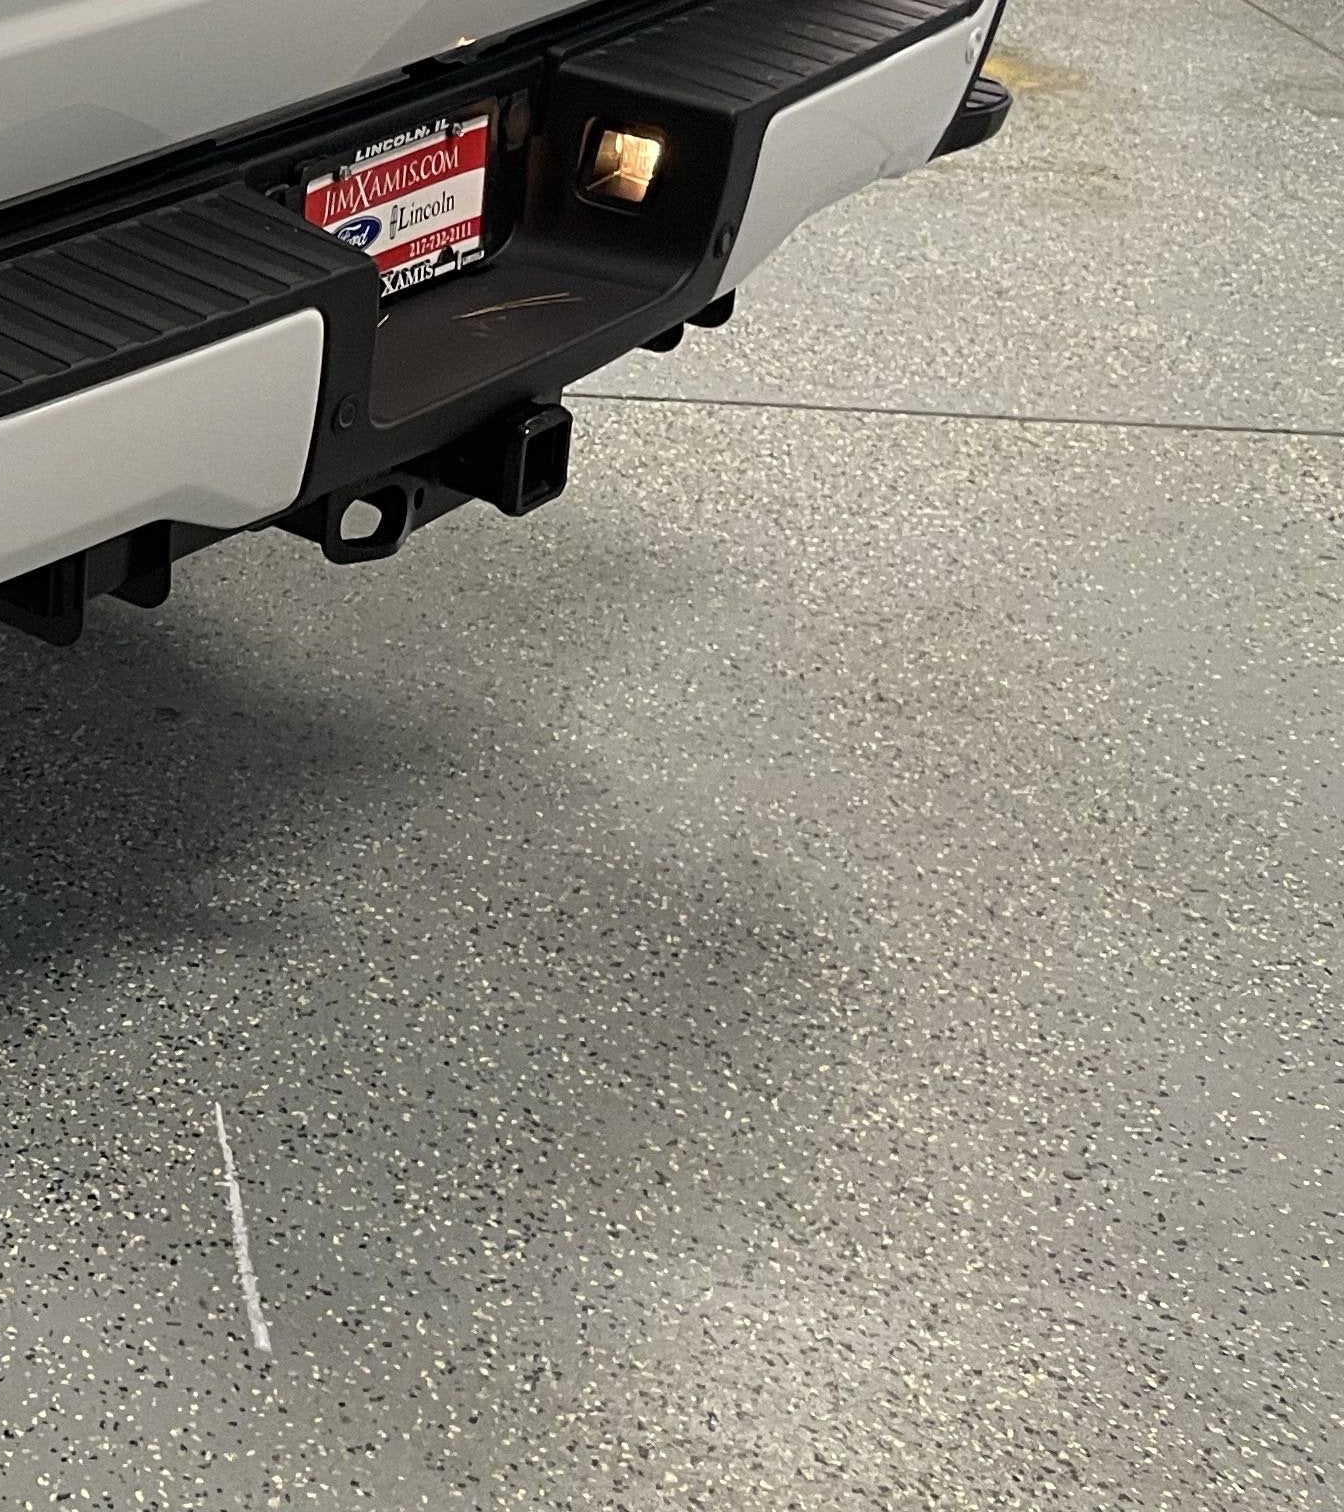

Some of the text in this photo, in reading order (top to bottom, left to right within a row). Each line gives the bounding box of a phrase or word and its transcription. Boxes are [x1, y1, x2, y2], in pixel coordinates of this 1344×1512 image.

[434, 117, 450, 134] IL
[398, 191, 455, 232] Lincoln
[409, 221, 472, 257] 217-732-2111
[380, 264, 433, 298] XAMIS
